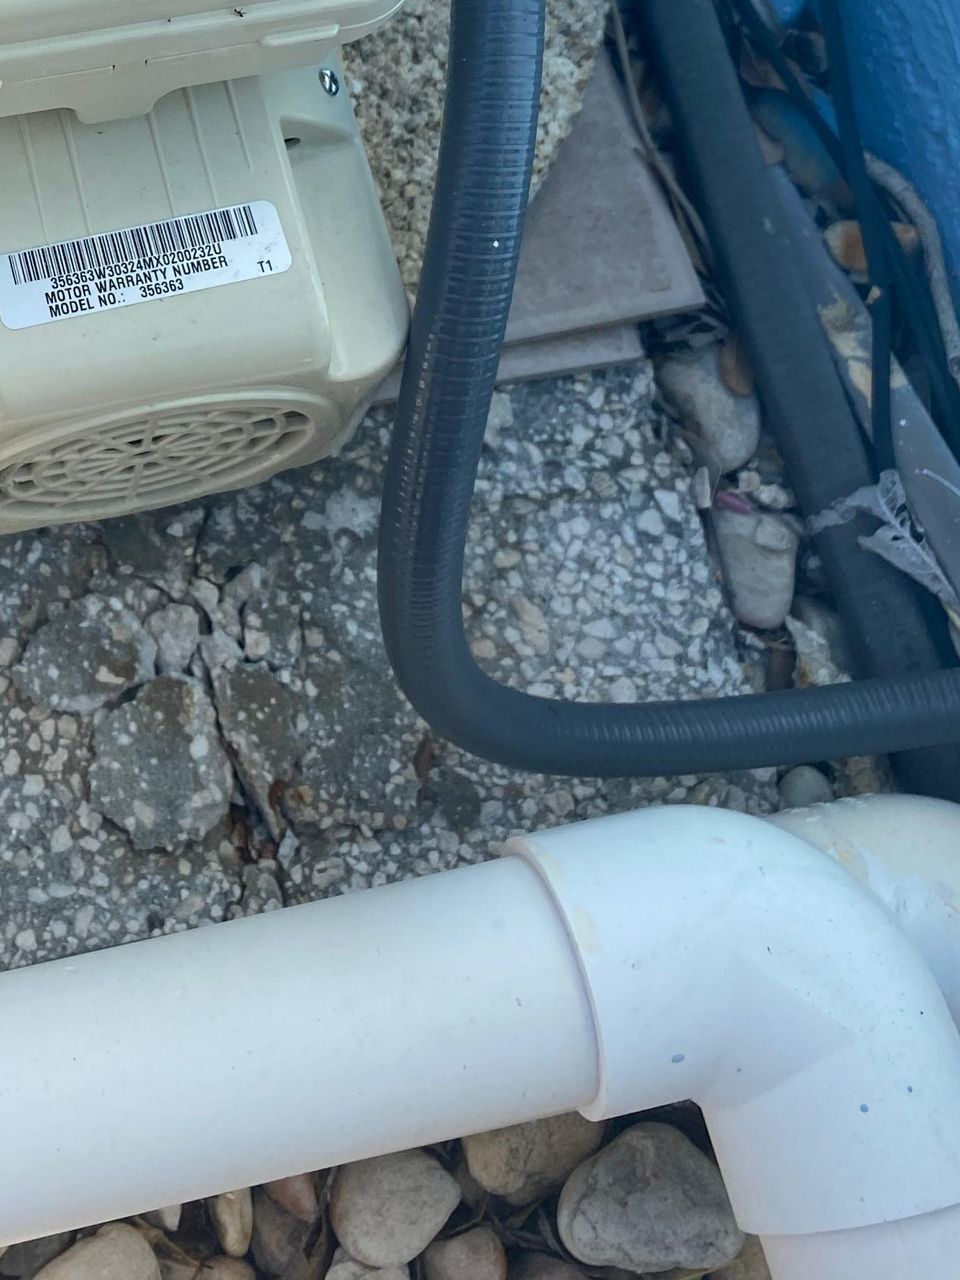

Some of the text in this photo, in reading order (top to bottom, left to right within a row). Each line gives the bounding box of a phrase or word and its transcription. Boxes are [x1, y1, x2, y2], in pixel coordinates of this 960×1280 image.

[44, 255, 228, 304] MOTOR WARRANTY NUMBER
[50, 242, 222, 289] 356363W30324MX0200232U
[256, 259, 272, 273] T1
[48, 277, 184, 318] MODEL NO.: 356363
